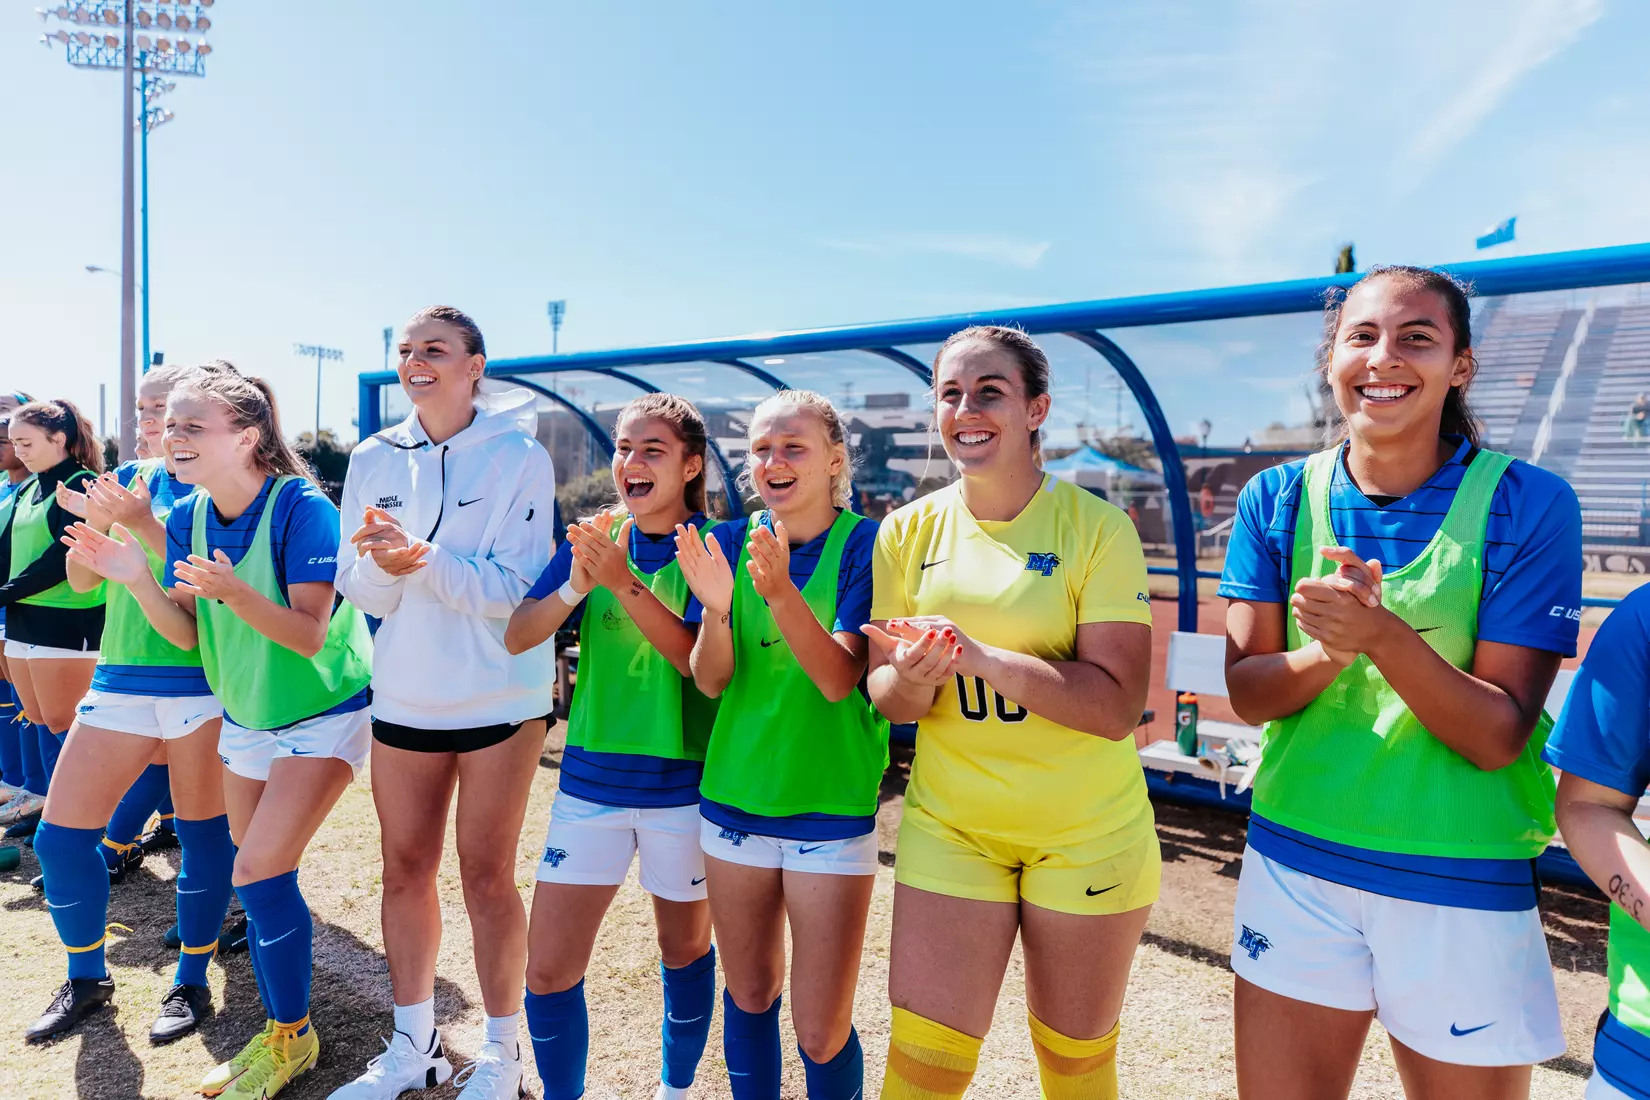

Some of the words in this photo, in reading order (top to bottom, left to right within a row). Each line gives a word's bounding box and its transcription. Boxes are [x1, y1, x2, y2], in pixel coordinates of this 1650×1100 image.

[1025, 552, 1061, 576] MT
[627, 640, 652, 691] 4
[1178, 711, 1191, 726] G
[544, 847, 569, 868] MT
[1238, 924, 1274, 960] MT
